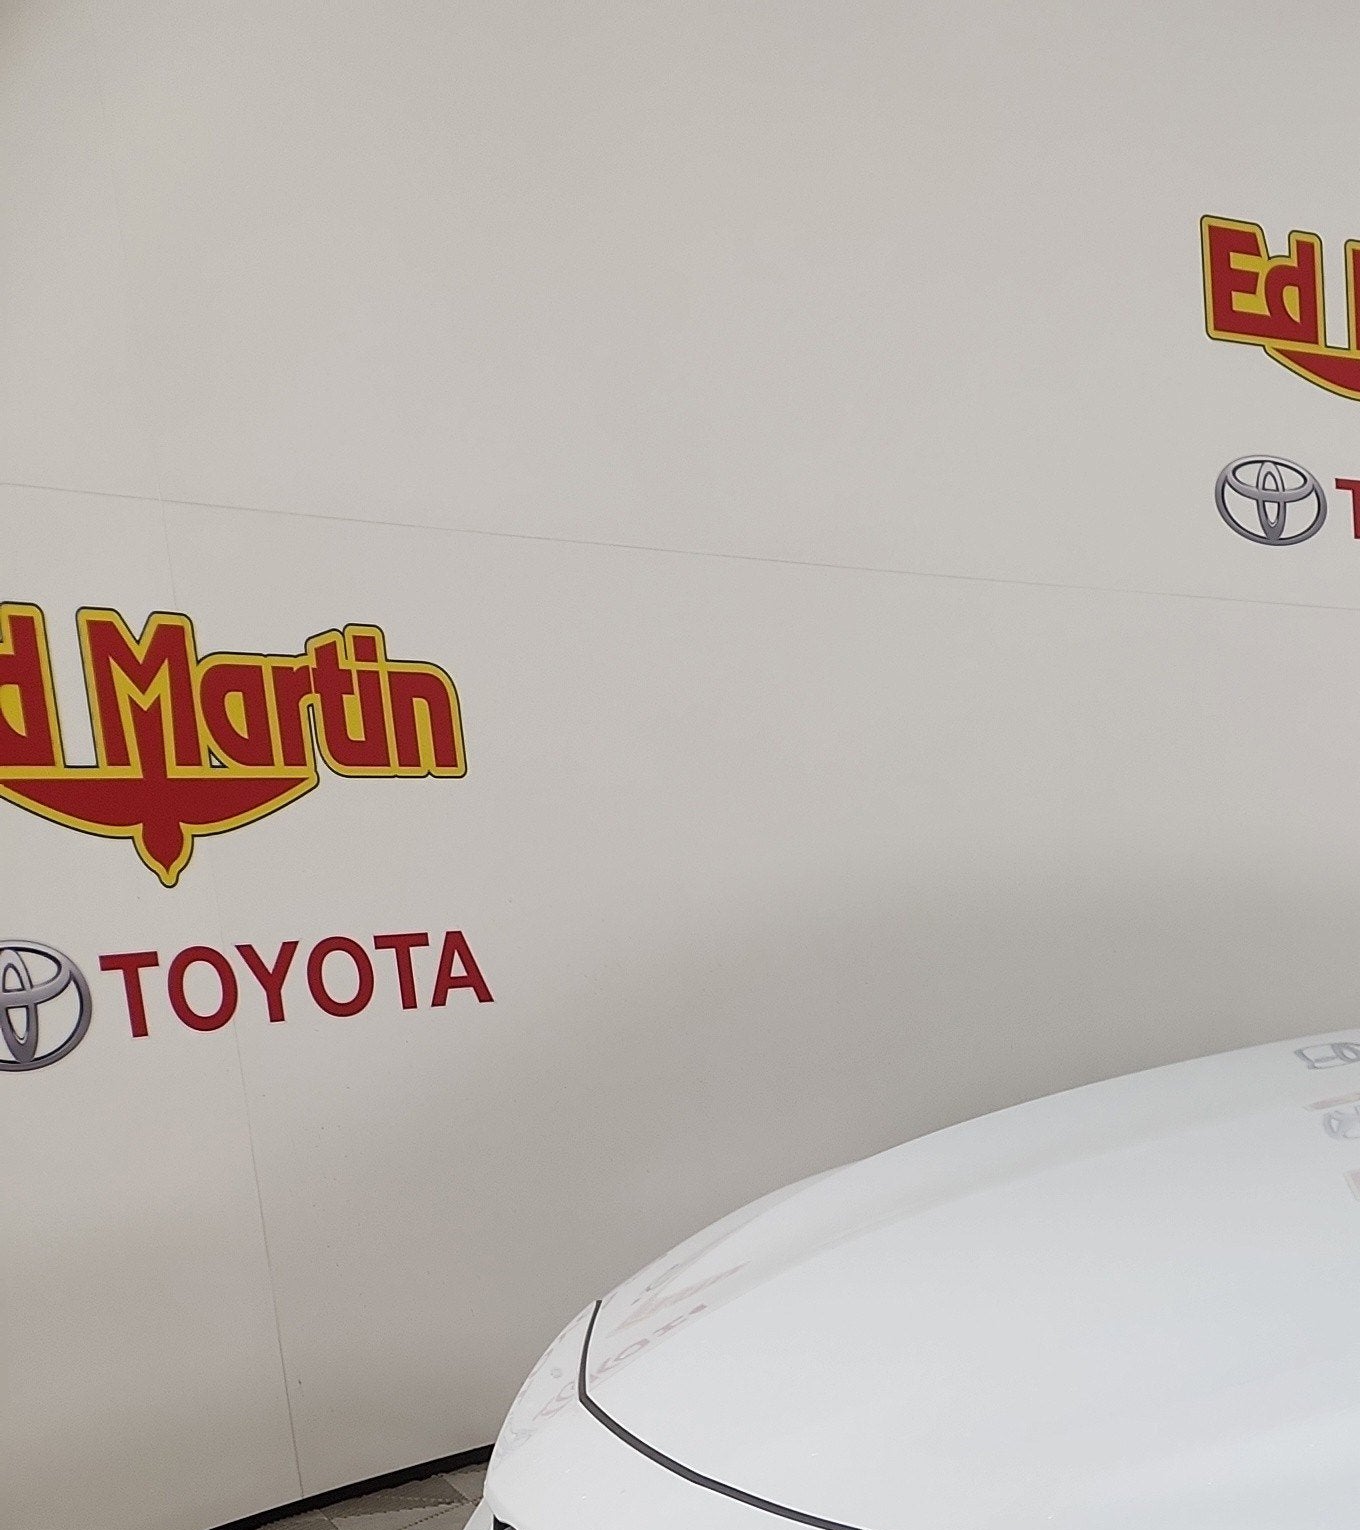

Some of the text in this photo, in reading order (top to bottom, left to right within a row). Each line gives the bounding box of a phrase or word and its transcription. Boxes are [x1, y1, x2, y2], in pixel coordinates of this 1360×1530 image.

[1202, 216, 1324, 347] Ed
[76, 606, 467, 778] Martin
[99, 930, 494, 1039] TOYOTA
